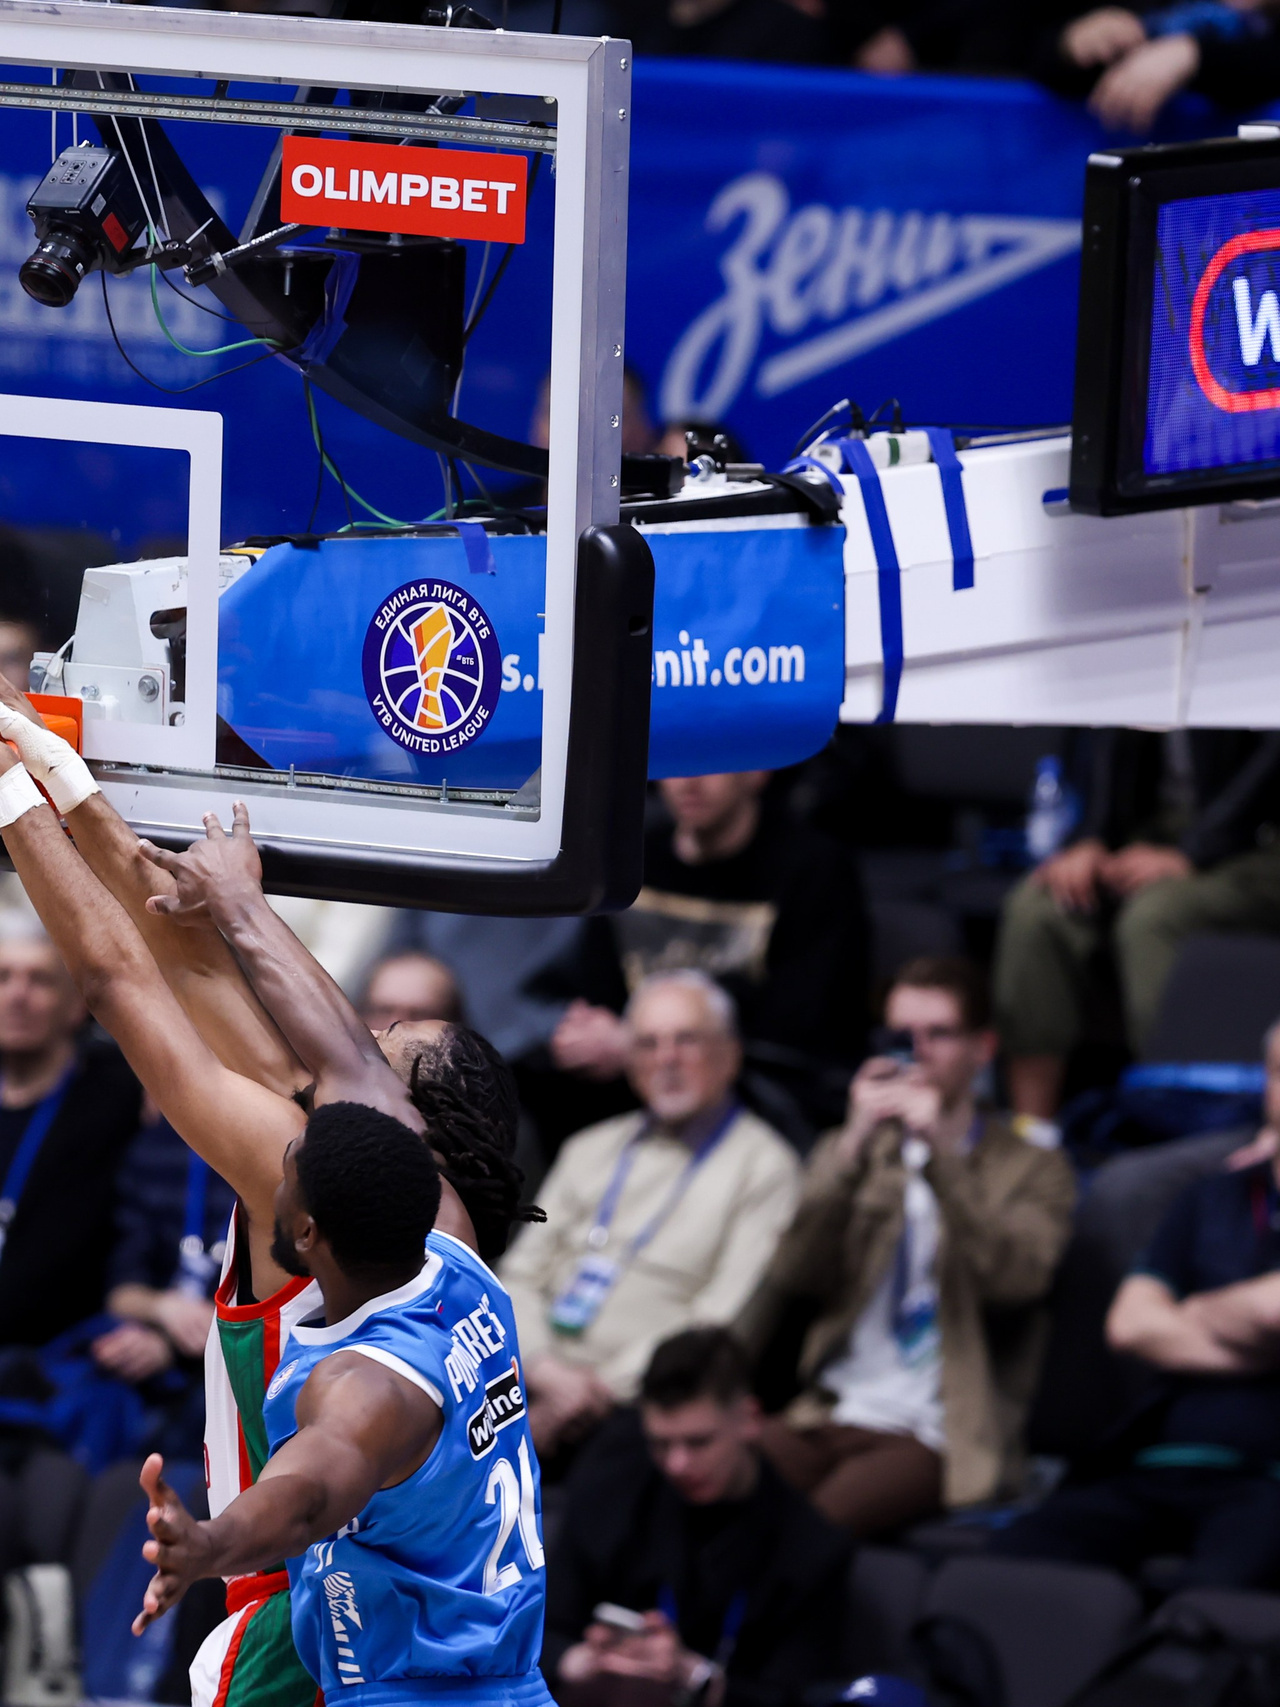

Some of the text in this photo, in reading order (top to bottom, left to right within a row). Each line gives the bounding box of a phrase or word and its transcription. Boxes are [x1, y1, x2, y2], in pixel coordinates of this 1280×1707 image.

[291, 164, 517, 214] OLIMPBET
[374, 584, 491, 640] ЕДИНАЯ ЛИГА ВТБ
[372, 694, 490, 753] VTB UNITED LEAGUE
